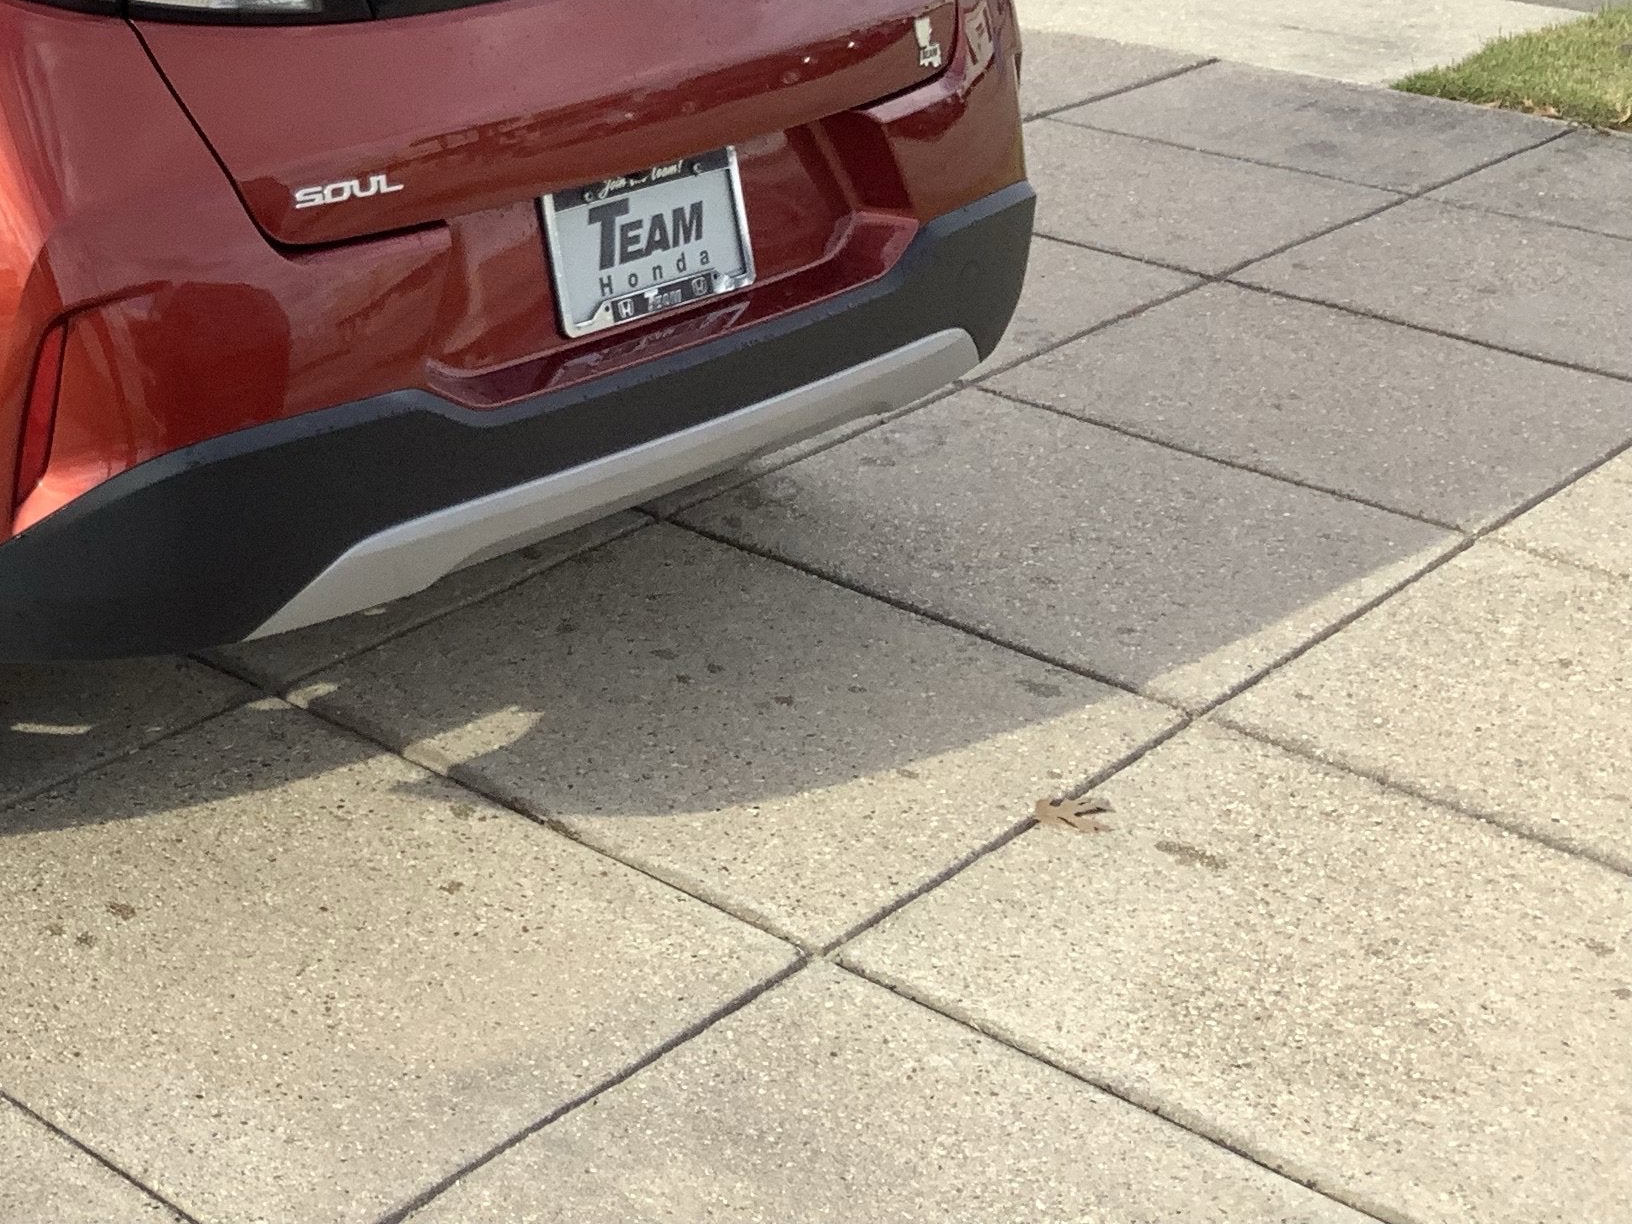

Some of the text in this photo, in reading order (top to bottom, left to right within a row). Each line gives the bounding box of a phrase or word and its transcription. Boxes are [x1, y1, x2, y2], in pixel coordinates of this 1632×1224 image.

[294, 174, 405, 209] SOUL
[587, 197, 704, 272] TEAM
[598, 249, 711, 297] Honda
[643, 287, 683, 313] TEAM
